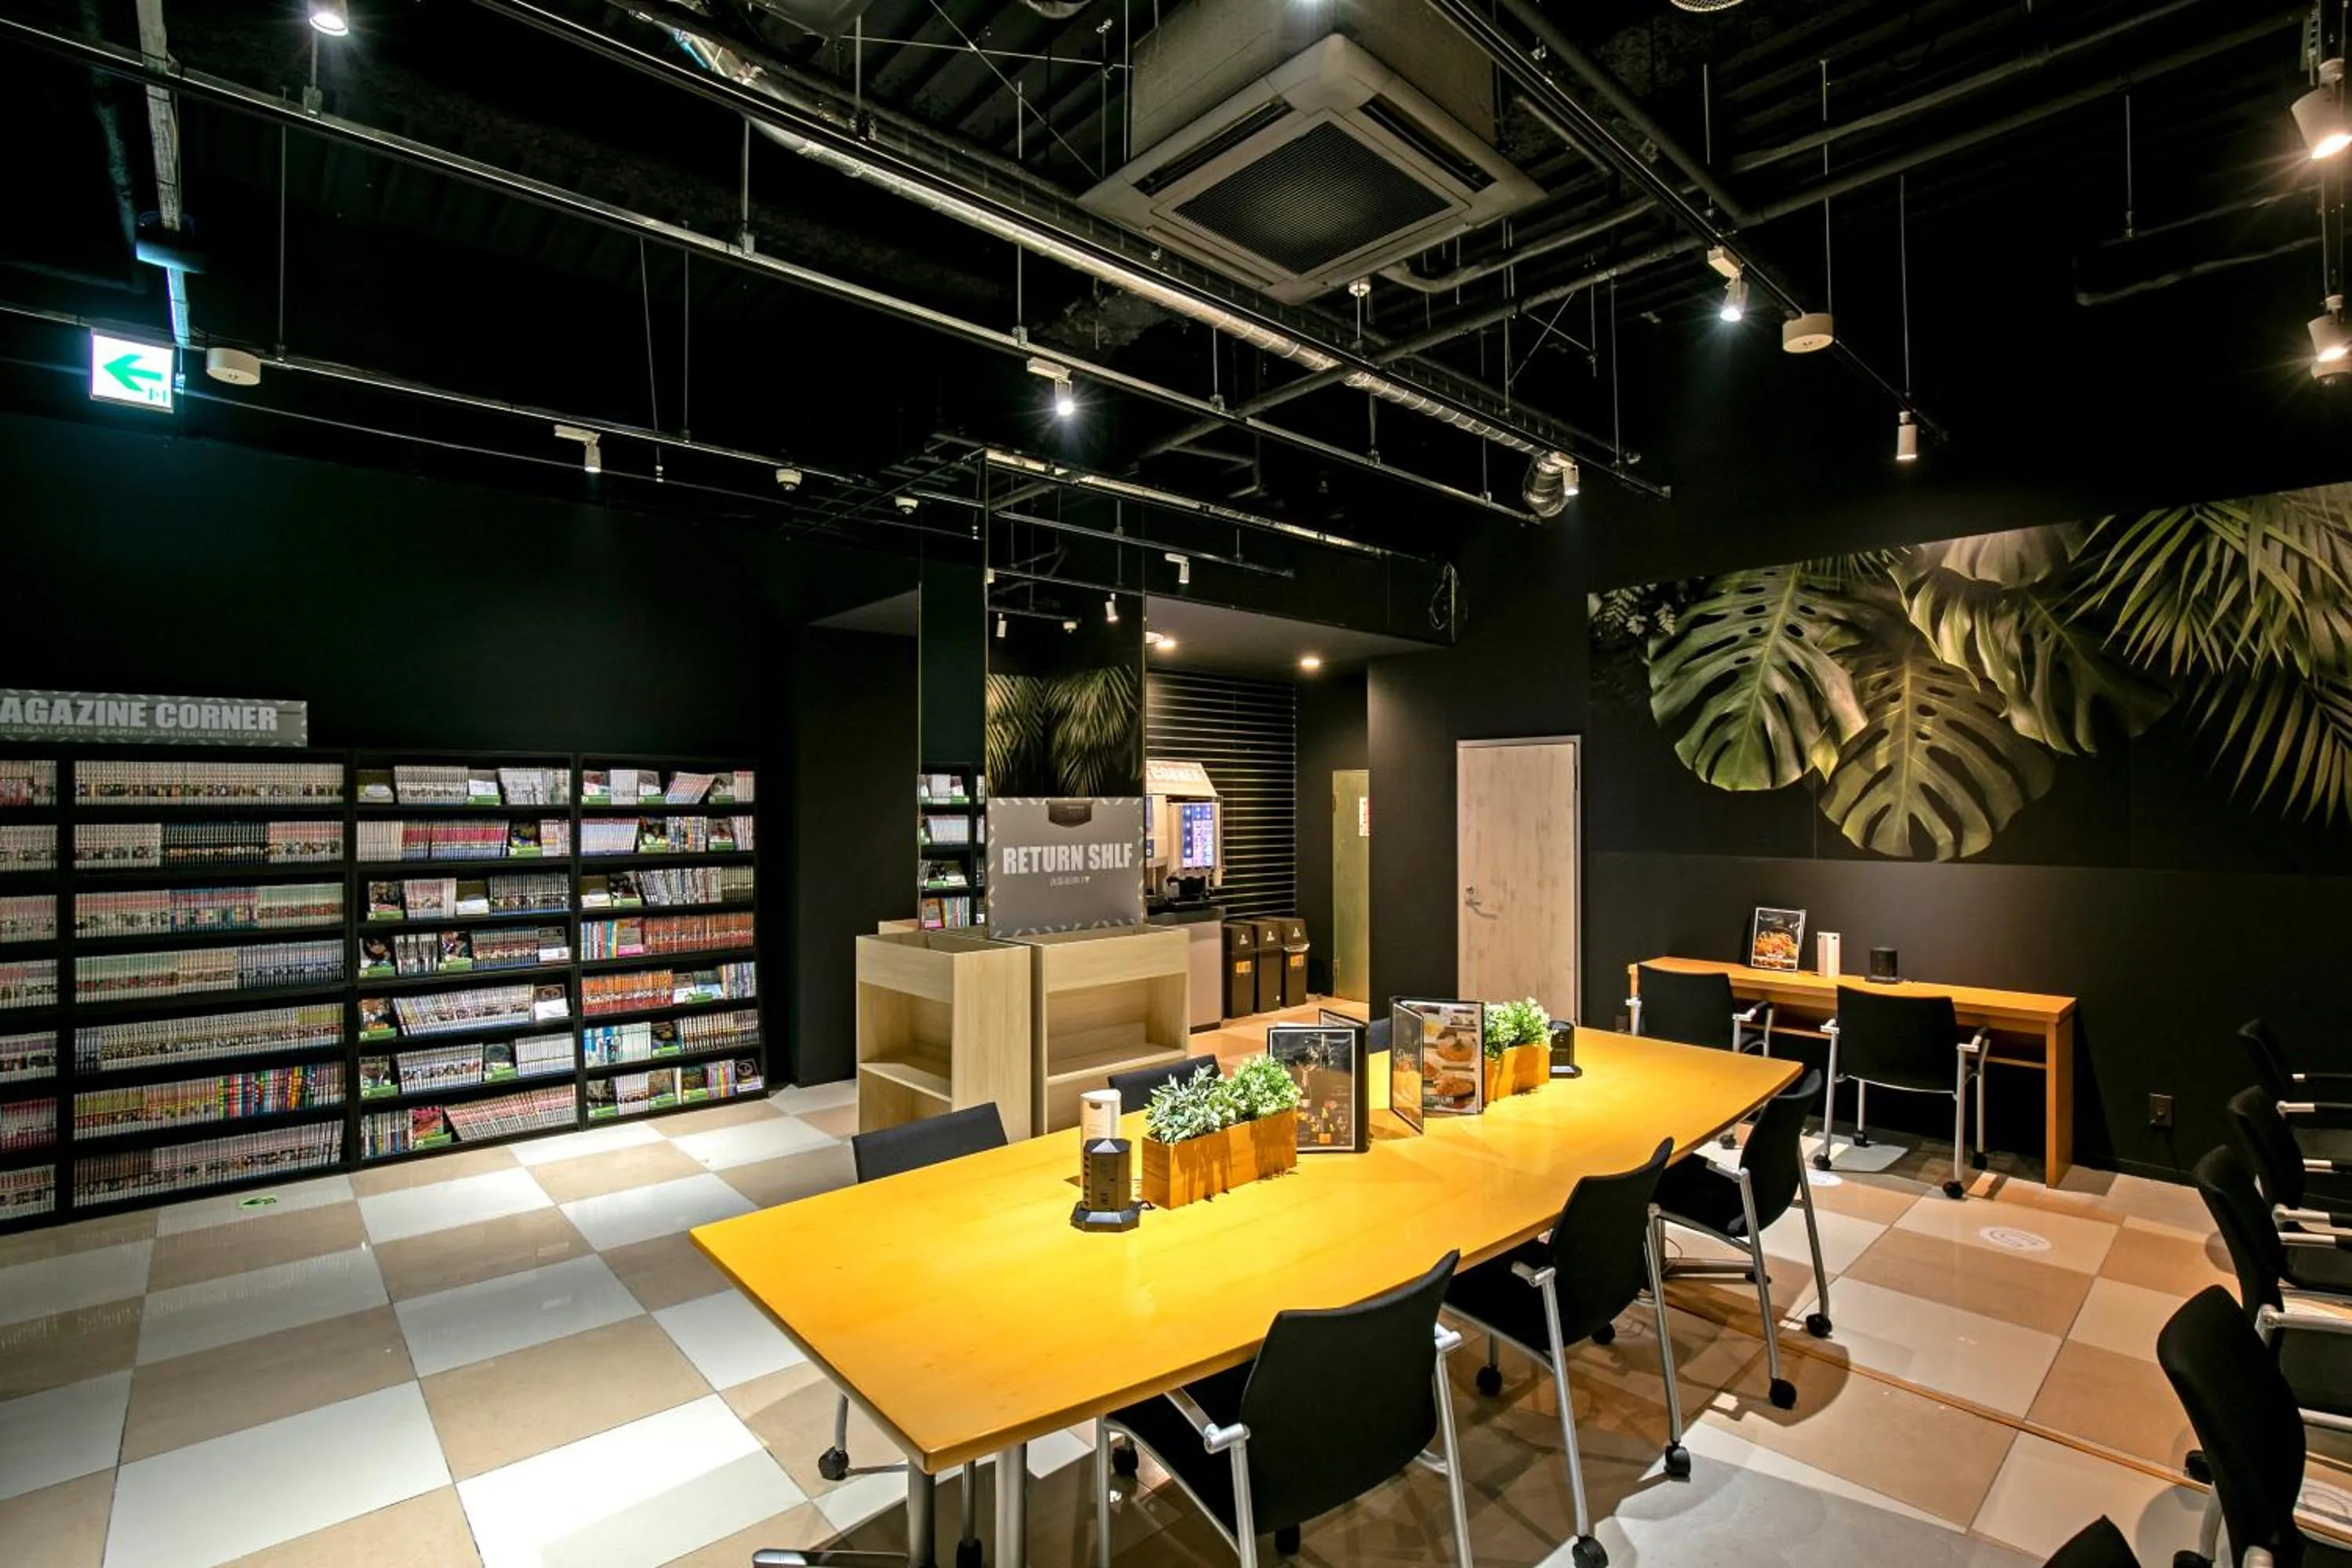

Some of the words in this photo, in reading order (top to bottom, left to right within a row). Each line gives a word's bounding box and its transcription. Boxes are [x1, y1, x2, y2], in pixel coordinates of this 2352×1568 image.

[155, 702, 277, 731] CORNER
[1003, 844, 1083, 874] RETURN
[1088, 842, 1133, 870] SHLF
